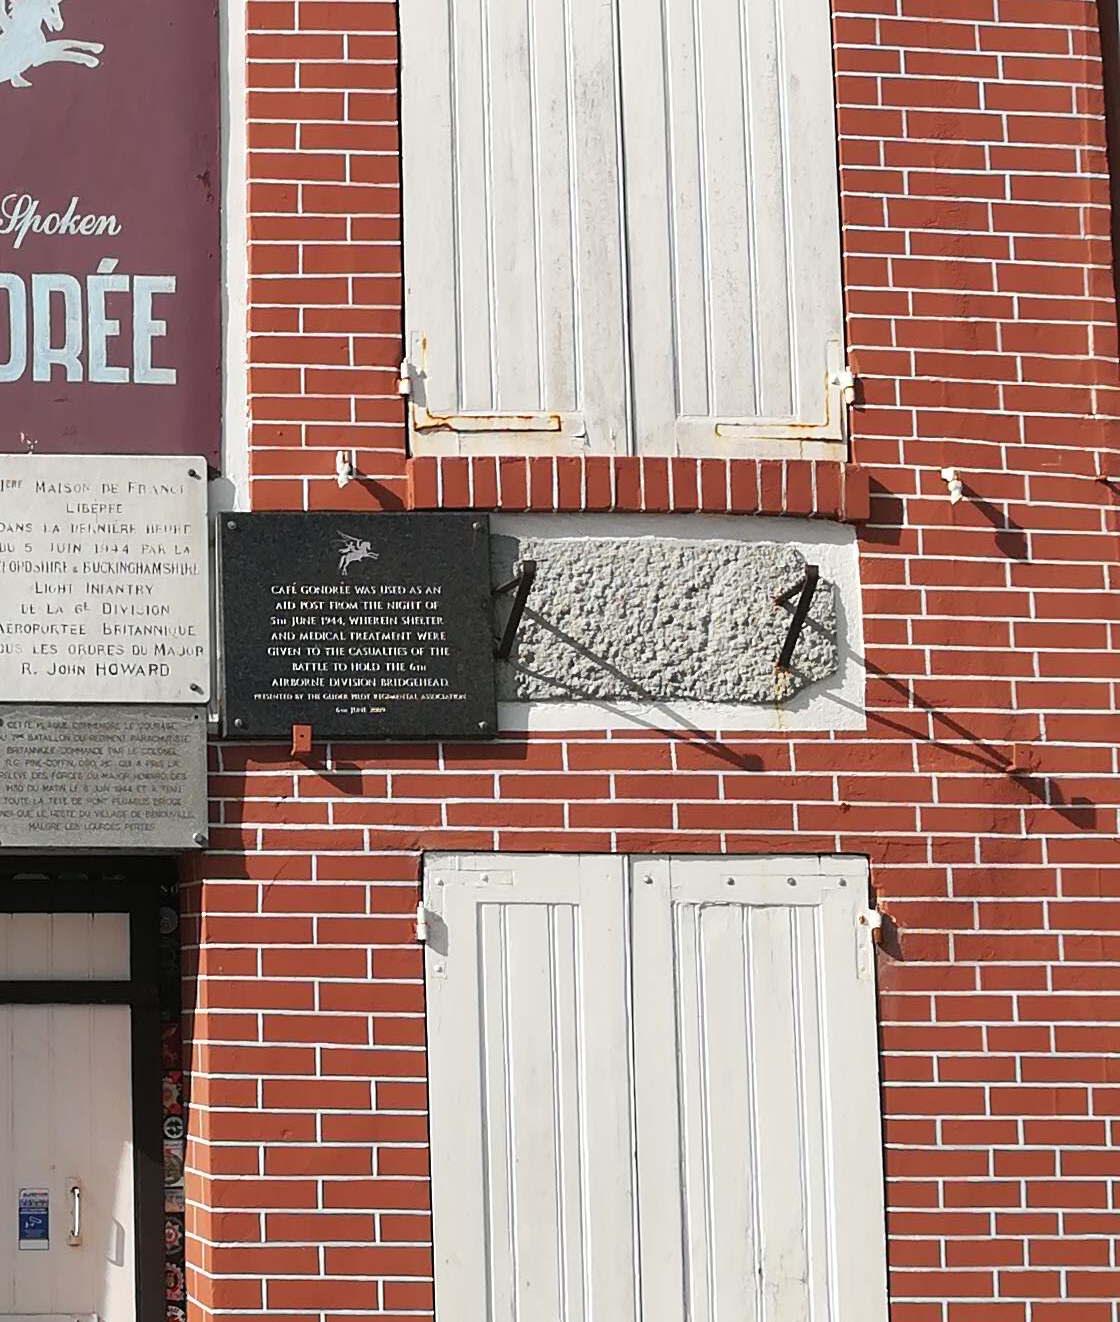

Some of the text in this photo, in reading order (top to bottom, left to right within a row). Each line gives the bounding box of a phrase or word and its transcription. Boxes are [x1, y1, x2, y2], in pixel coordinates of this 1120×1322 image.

[36, 481, 90, 493] MAISON
[102, 483, 118, 494] DE
[44, 523, 60, 534] LA
[0, 542, 190, 555] DU 5 JUIN 1944 PAR LA
[83, 561, 200, 575] BUCKINGHAMSHIRE
[35, 581, 153, 595] LIGHT INFANTRY
[271, 582, 297, 595] CAFÉ
[354, 586, 376, 595] WAS
[380, 586, 406, 595] USED
[409, 586, 422, 595] AS
[425, 586, 442, 595] AN
[21, 603, 36, 614] DE
[47, 603, 64, 614] LA
[102, 602, 170, 615] DIVISION
[275, 601, 440, 610] AID POST FROM THE NIGHT OF
[291, 616, 316, 626] JUNE
[349, 616, 398, 626] WHEREIN
[401, 616, 444, 626] SHELTER
[103, 623, 196, 638] BRITANNIQUE
[271, 632, 446, 641] AND MEDICAL TREATMENT WERE
[32, 644, 58, 655] LES
[68, 644, 124, 656] ORDRES
[132, 644, 148, 656] DU
[154, 644, 204, 656] MAJOR
[267, 647, 450, 656] GIVEN TO THE CASUALTIES OF THE
[21, 662, 170, 677] R. JOHN HOWARD
[292, 662, 328, 671] BATTLE
[334, 662, 348, 671] TO
[351, 662, 380, 671] HOLD
[384, 662, 406, 671] THE
[271, 678, 450, 687] AIRBORNE DIVISION BRIDGEHEAD
